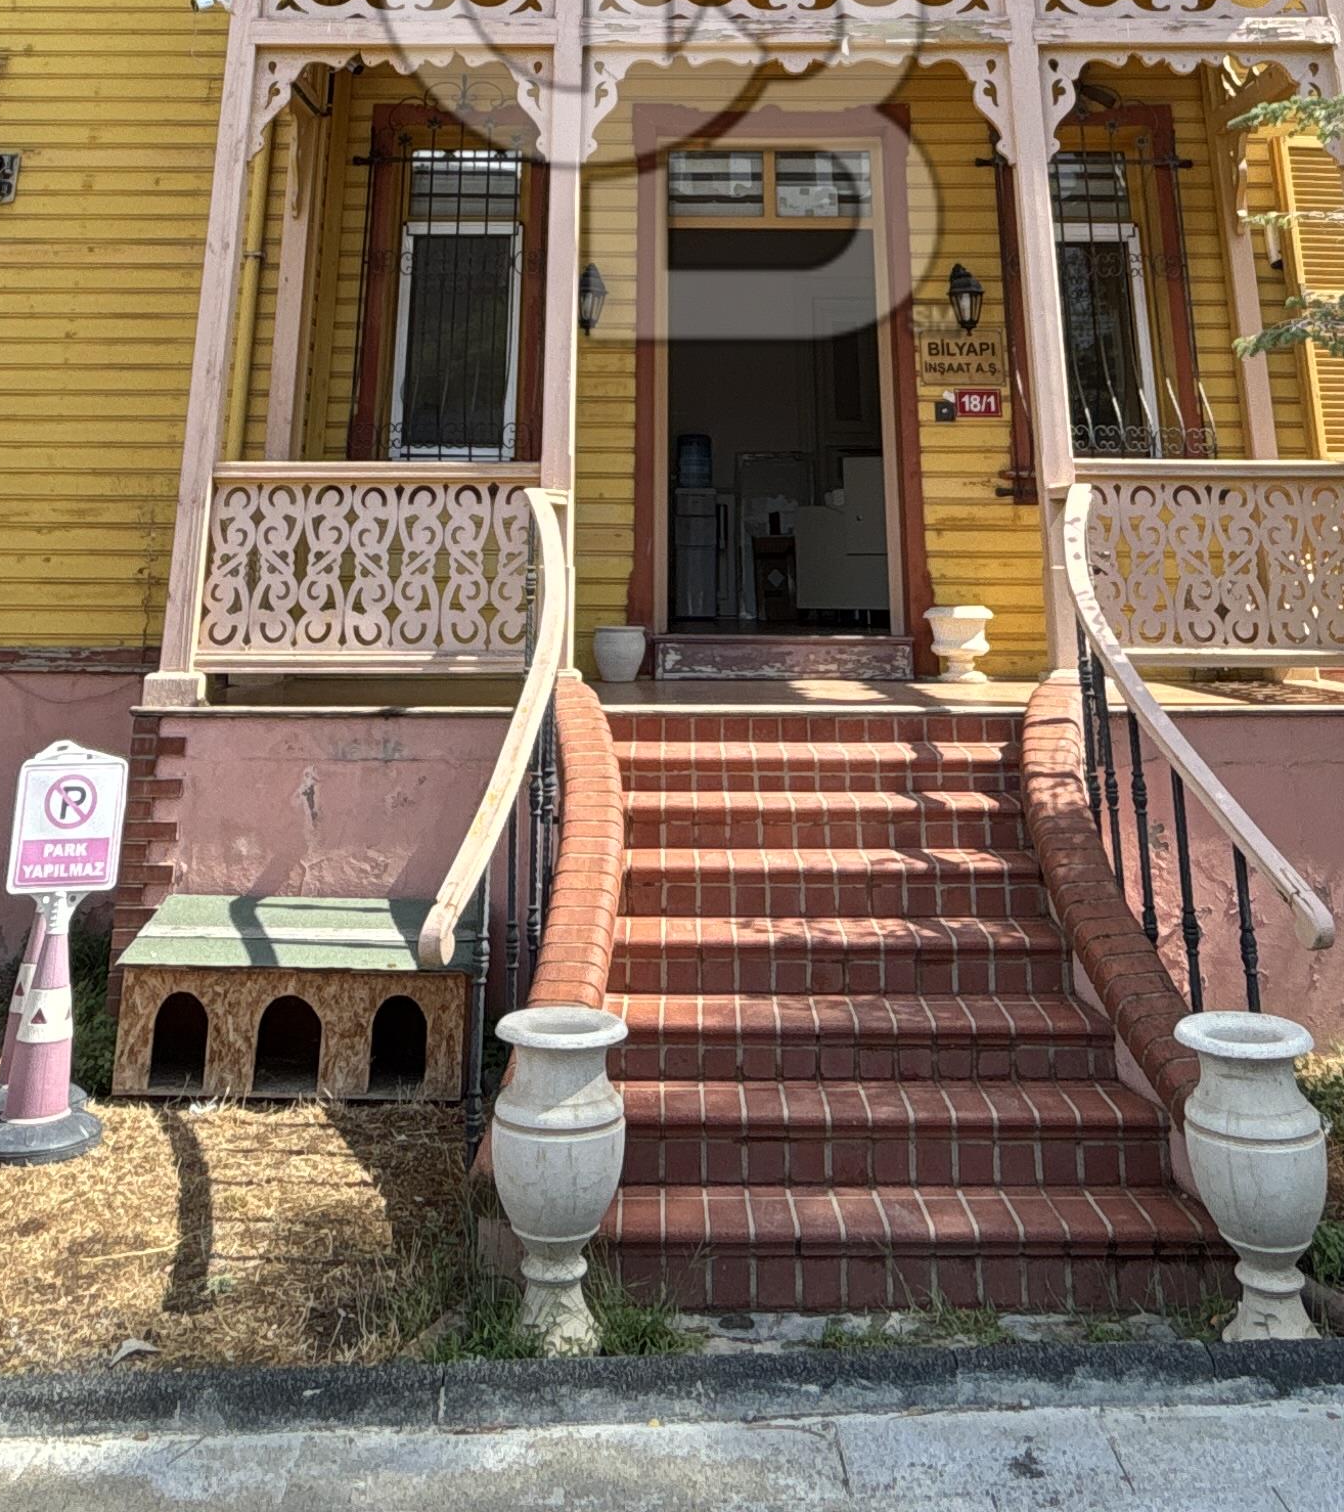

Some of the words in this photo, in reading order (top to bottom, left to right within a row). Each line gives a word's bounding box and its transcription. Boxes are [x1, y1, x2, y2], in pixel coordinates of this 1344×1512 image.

[927, 339, 996, 357] BİLYAPI
[924, 361, 972, 376] İNŞAAT
[975, 363, 1001, 376] A.Ş.
[961, 394, 996, 412] 18/1
[42, 843, 89, 858] PARK
[22, 861, 105, 879] YAPILMAZ
